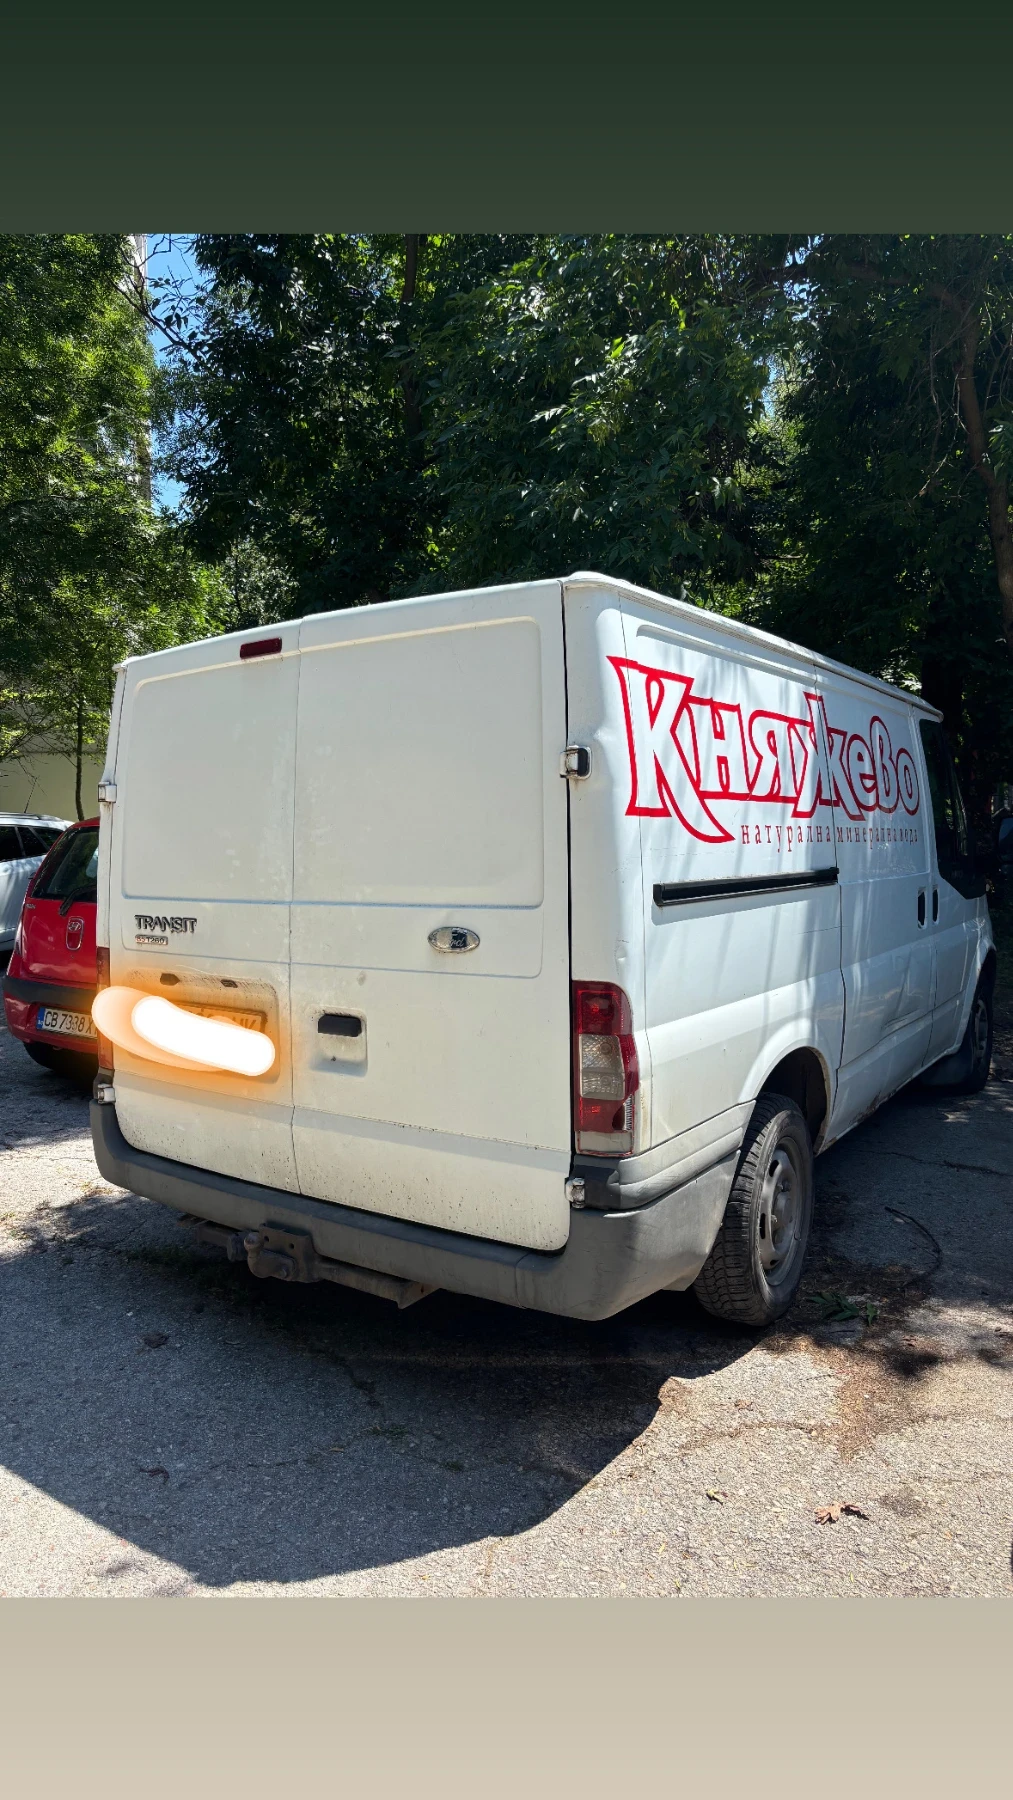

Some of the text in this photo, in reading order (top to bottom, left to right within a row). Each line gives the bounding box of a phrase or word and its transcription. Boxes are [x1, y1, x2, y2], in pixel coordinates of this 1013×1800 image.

[740, 824, 831, 853] натурална
[836, 826, 897, 849] минерална
[134, 914, 197, 933] TRANSIT
[44, 1011, 58, 1028] CB
